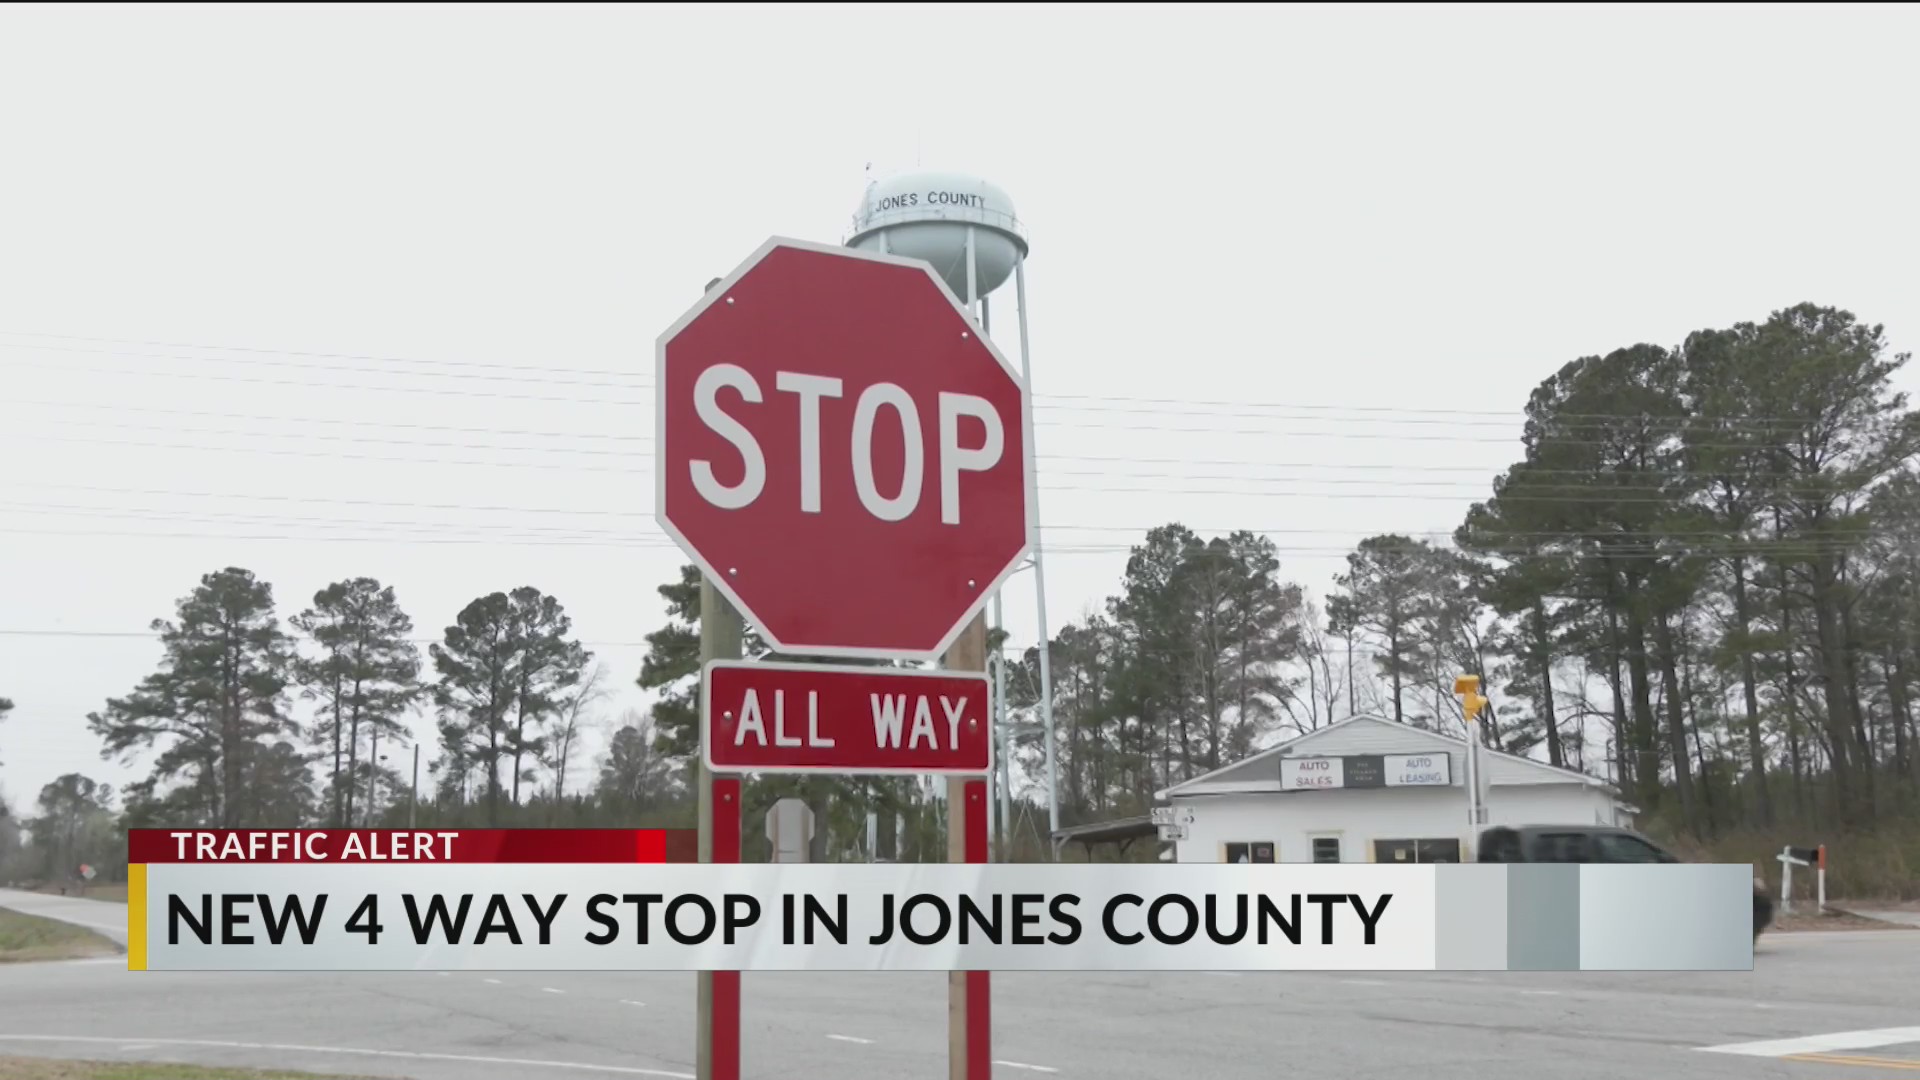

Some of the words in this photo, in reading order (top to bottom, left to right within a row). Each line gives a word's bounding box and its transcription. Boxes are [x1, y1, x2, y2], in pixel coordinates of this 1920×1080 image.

[875, 193, 918, 212] JONES
[927, 191, 985, 208] COUNTY
[689, 362, 1006, 526] STOP
[734, 688, 835, 747] ALL
[870, 692, 967, 751] WAY
[1299, 761, 1330, 771] AUTO
[1406, 757, 1432, 768] AUTO
[1296, 776, 1333, 787] SALES
[1399, 772, 1442, 784] LEASING
